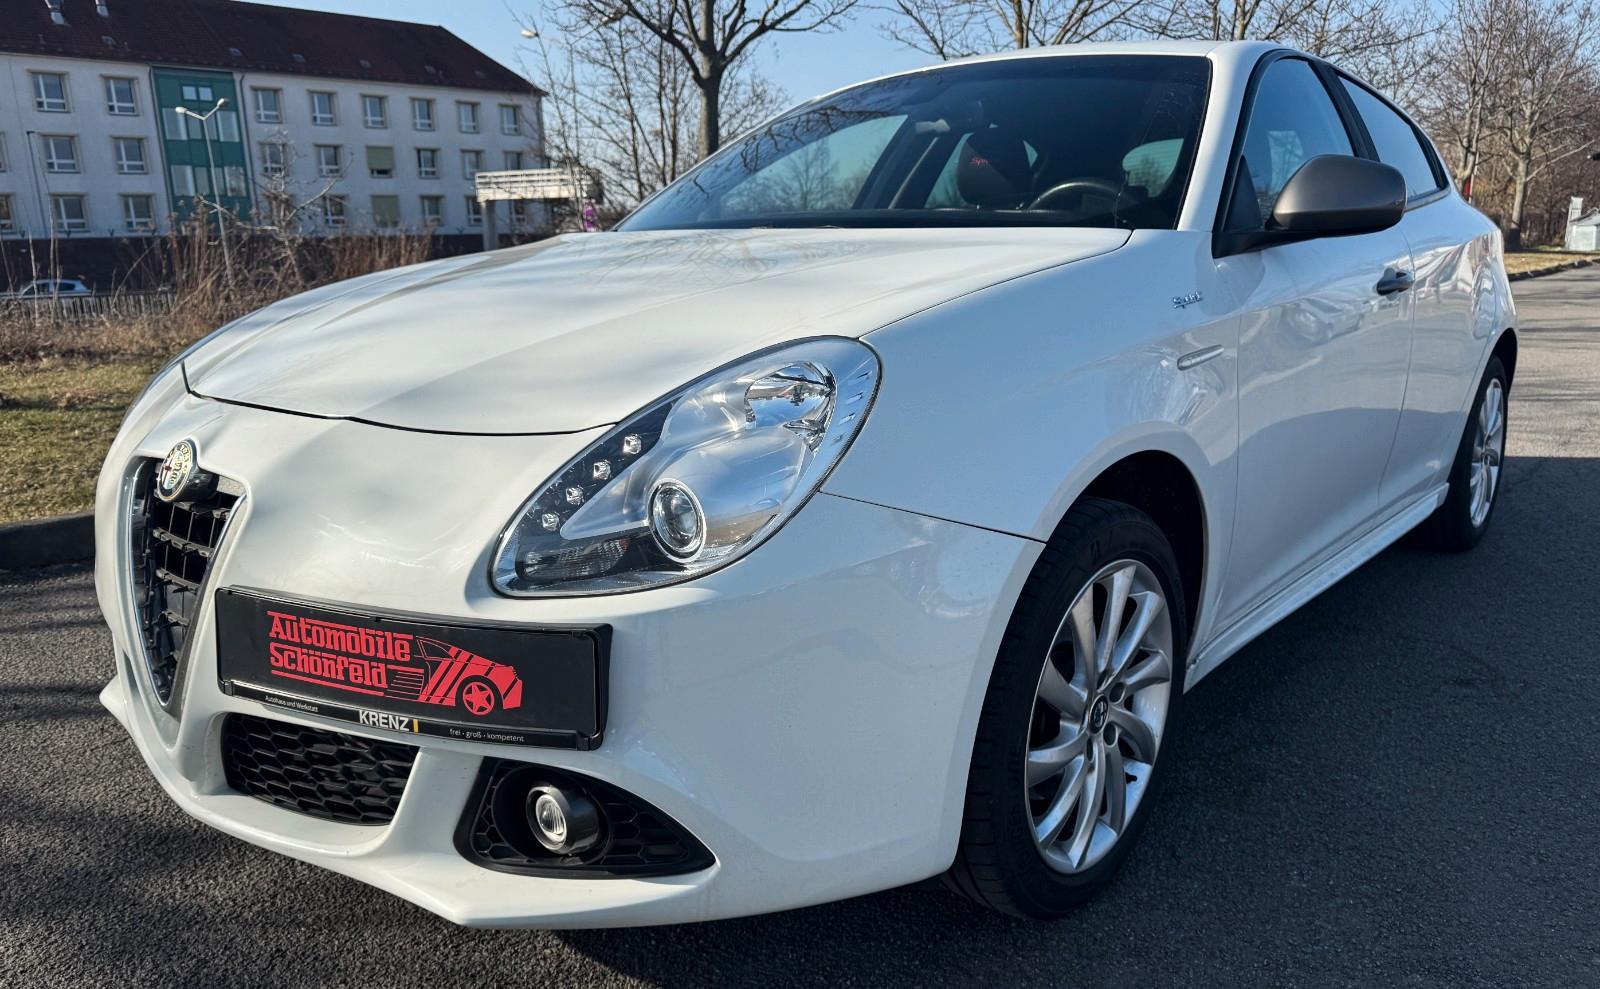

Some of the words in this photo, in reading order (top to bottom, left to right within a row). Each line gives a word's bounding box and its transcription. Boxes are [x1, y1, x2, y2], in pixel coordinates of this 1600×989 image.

[267, 611, 413, 661] Automobile
[269, 642, 388, 688] Schönfeld
[265, 695, 286, 705] Autohaus
[296, 702, 319, 712] Werkstatt
[359, 710, 410, 732] KRENZ
[449, 728, 461, 736] frei
[465, 731, 482, 739] groß
[486, 733, 524, 742] kompetent
